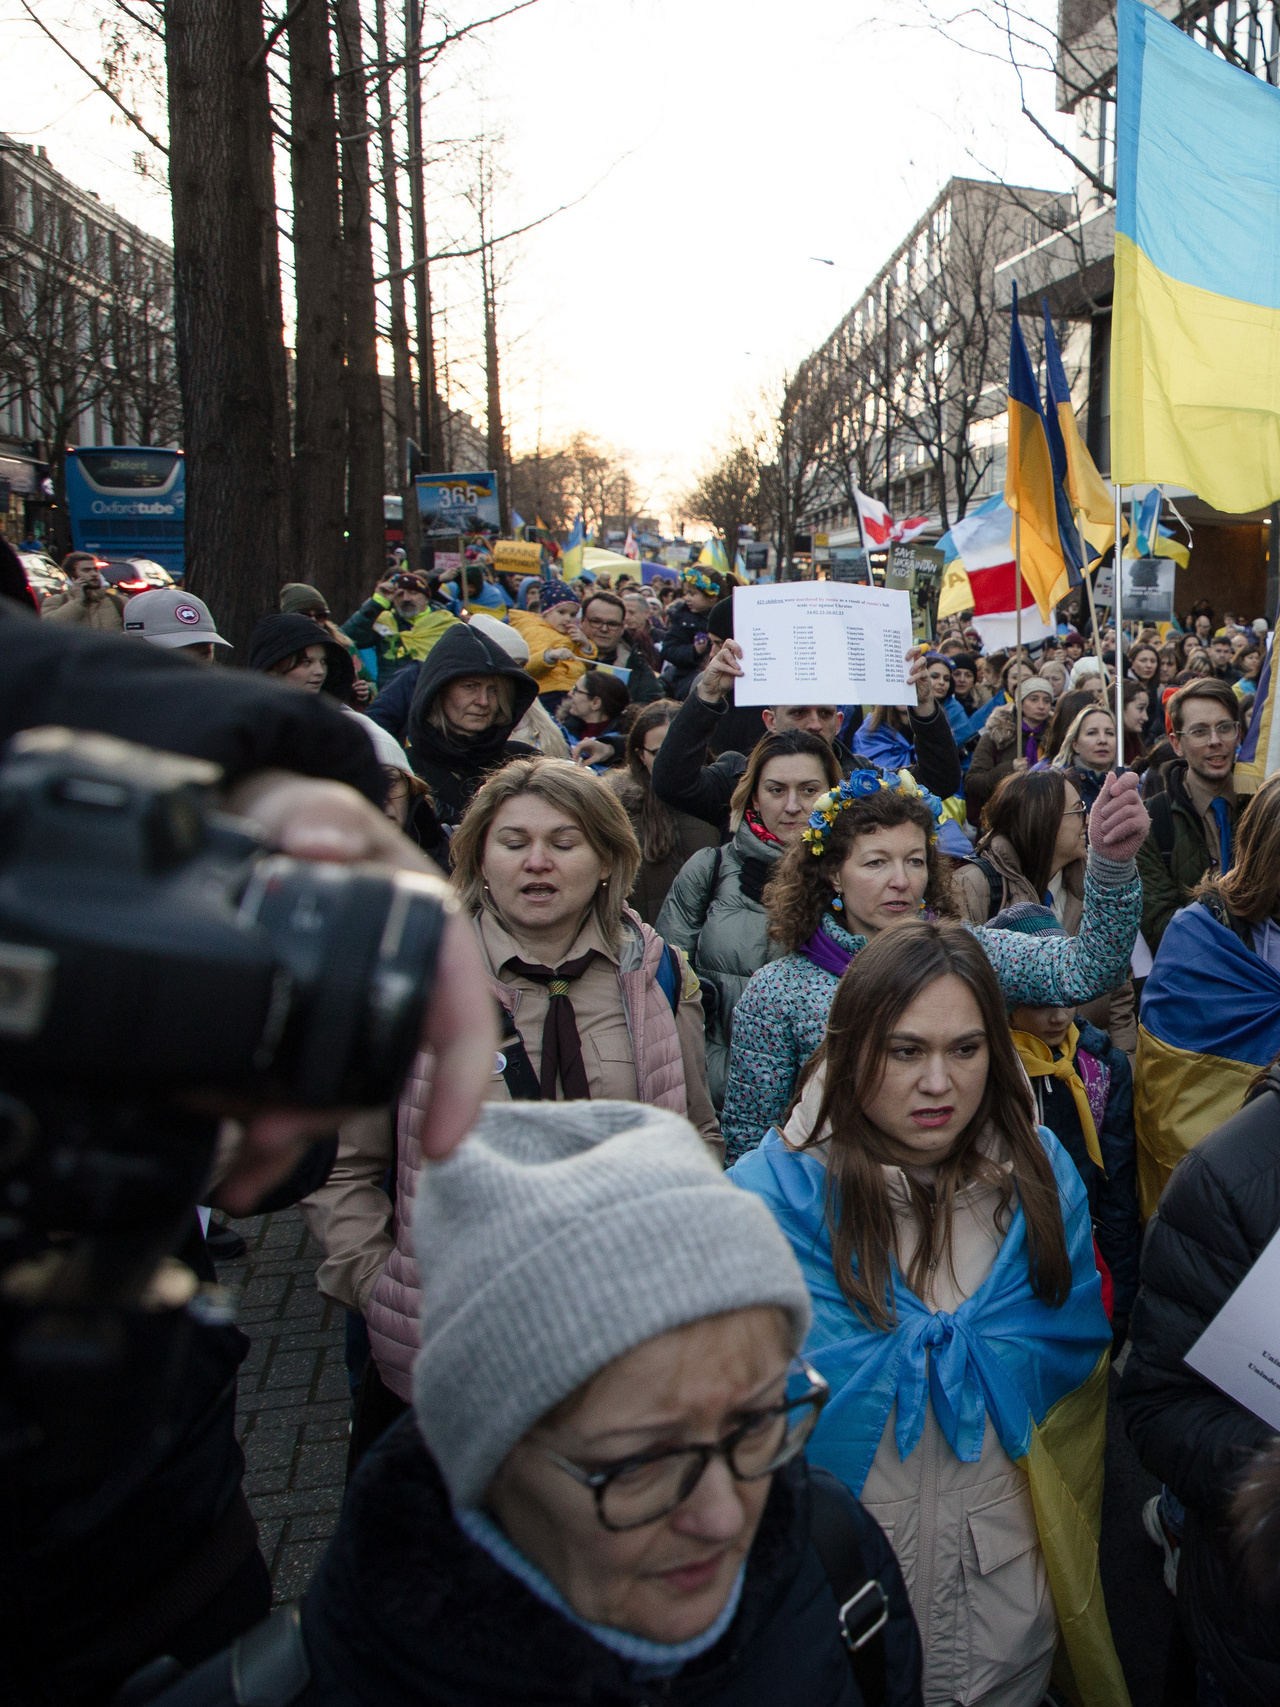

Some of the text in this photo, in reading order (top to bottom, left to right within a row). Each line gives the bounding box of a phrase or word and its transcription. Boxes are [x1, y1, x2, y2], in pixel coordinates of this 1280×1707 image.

[439, 486, 478, 508] 365
[894, 547, 916, 559] SAVE
[892, 566, 912, 579] KIDS
[894, 557, 938, 574] UKRAINIAN
